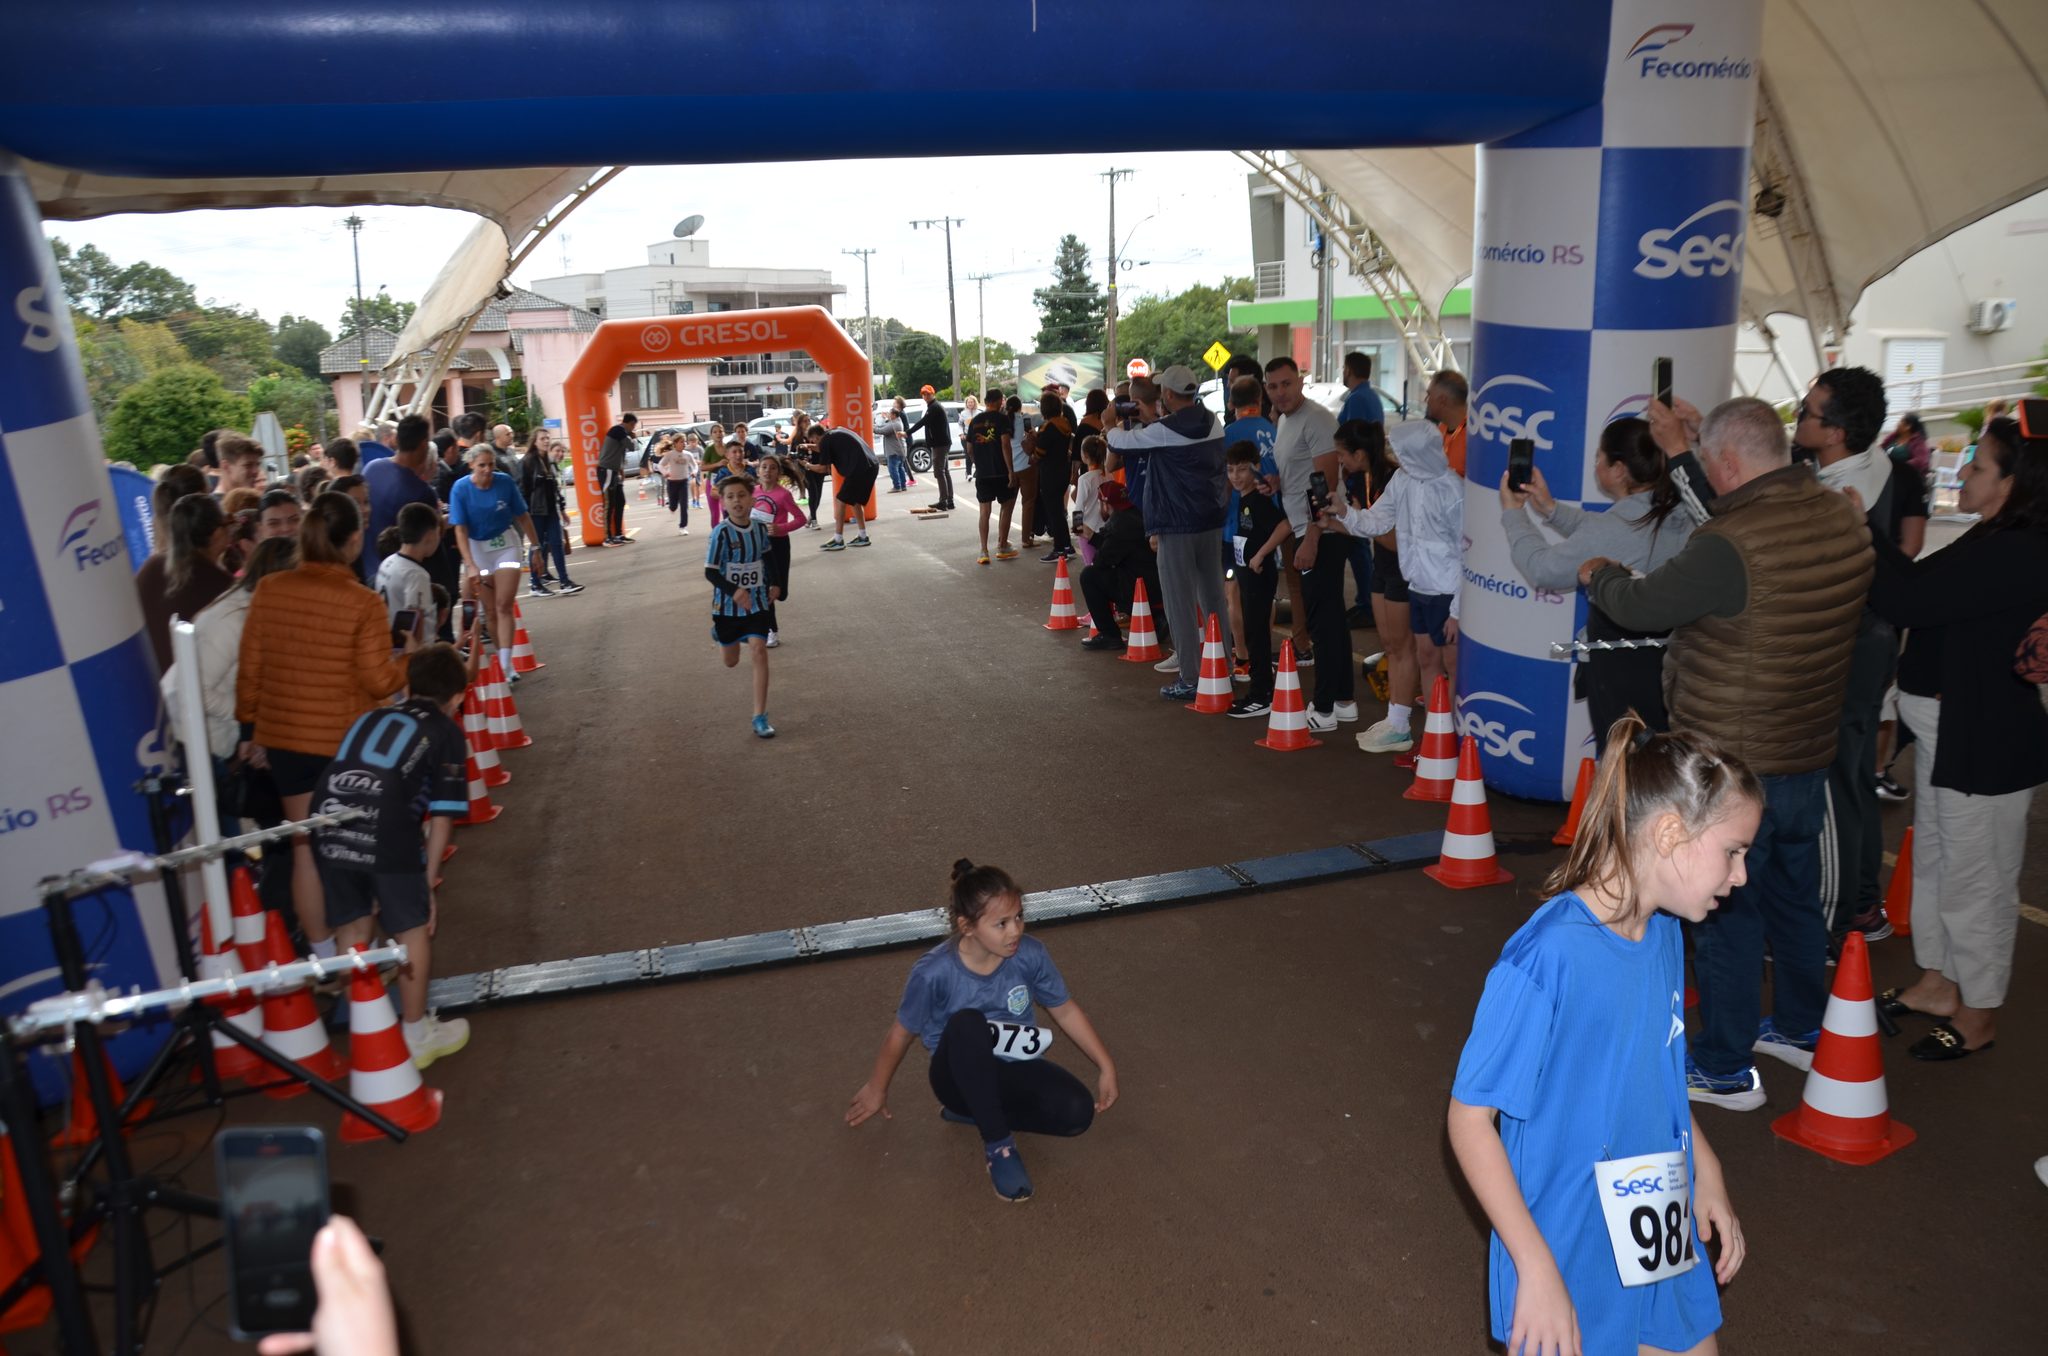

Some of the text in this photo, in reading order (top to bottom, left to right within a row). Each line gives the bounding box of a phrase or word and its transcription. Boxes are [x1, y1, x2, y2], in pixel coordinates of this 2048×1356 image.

[1641, 56, 1750, 79] Fecomércio
[1552, 245, 1584, 265] RS
[680, 320, 788, 346] CRESOL
[845, 385, 864, 436] SOL
[731, 571, 758, 586] 969
[1461, 563, 1528, 599] comércio
[328, 773, 384, 793] VITAL
[46, 786, 93, 820] RS
